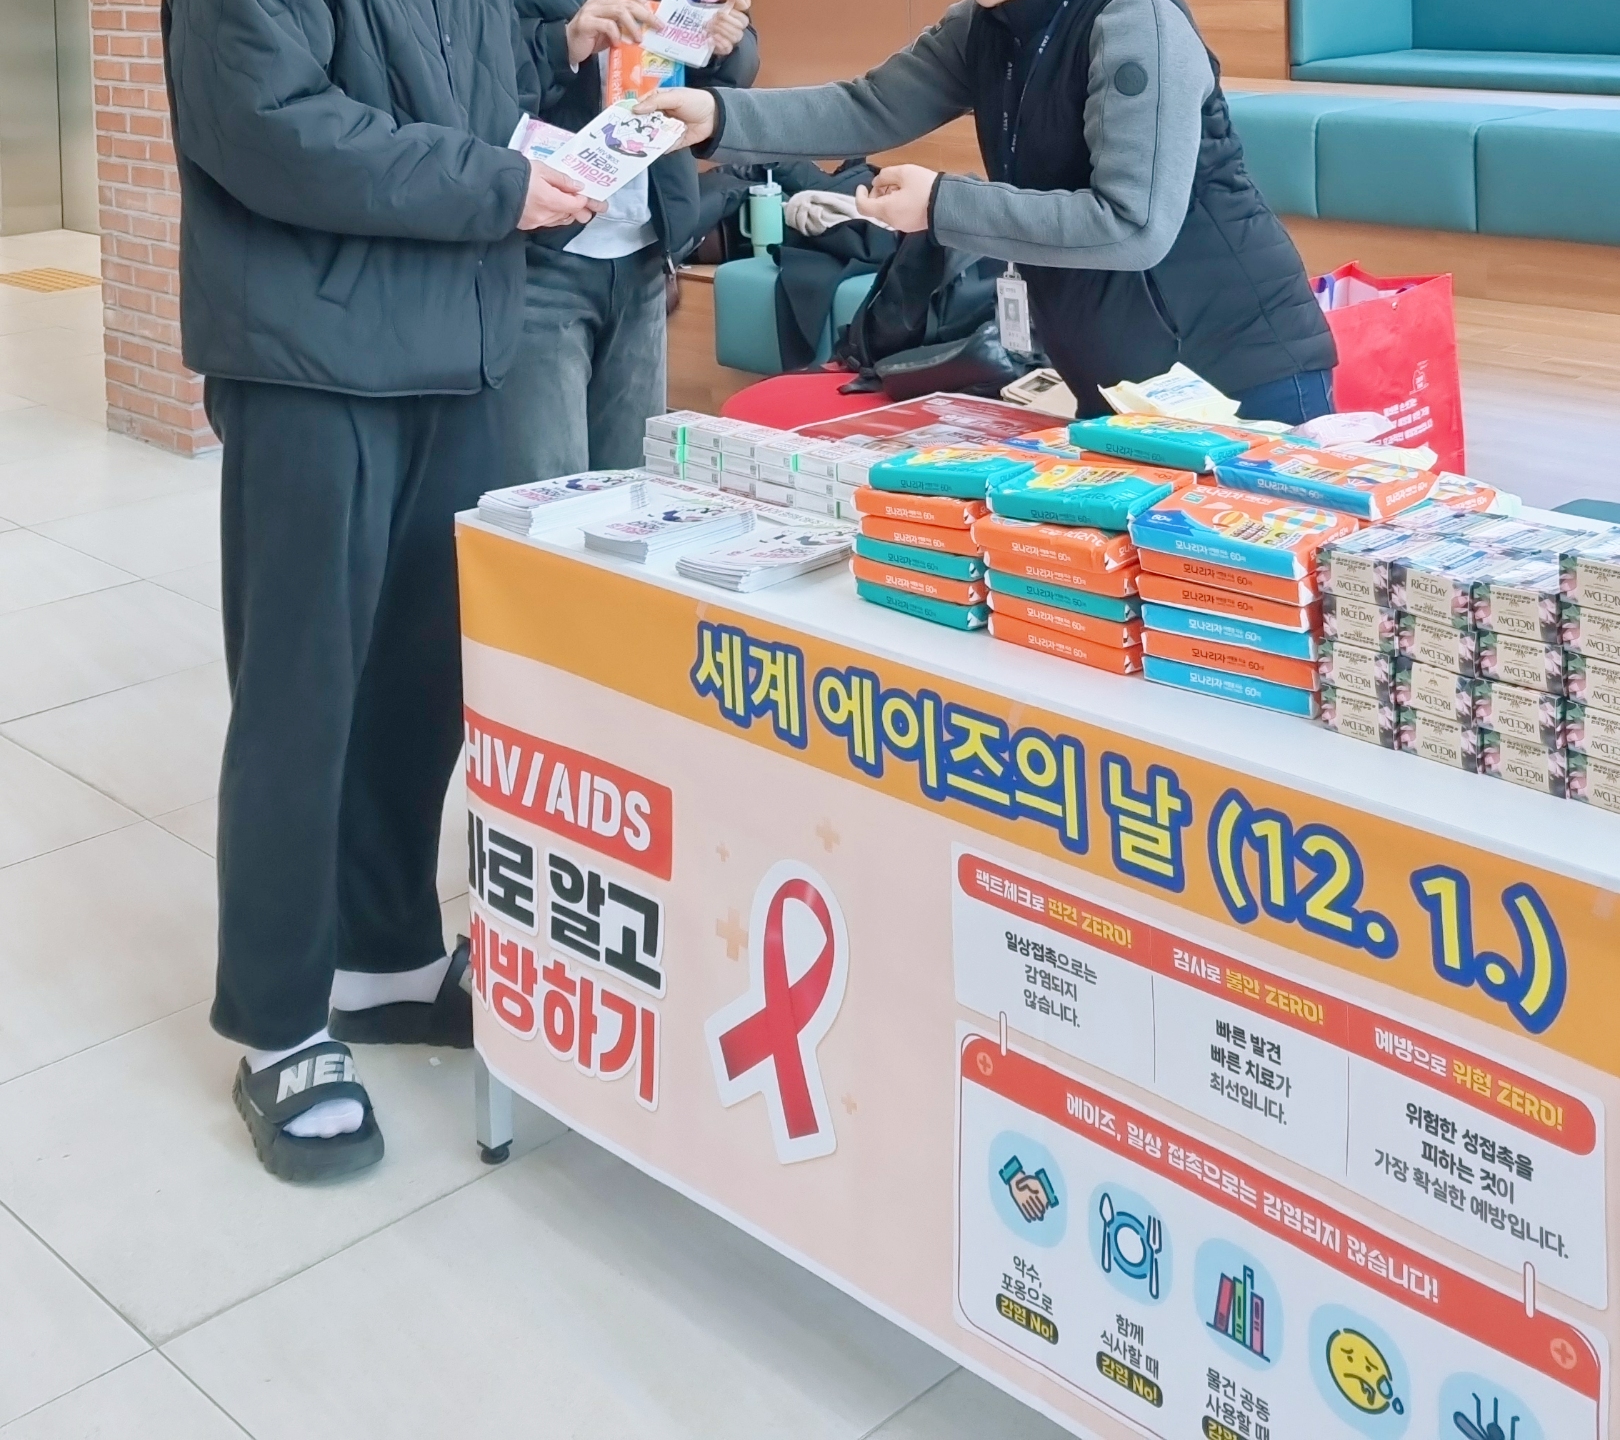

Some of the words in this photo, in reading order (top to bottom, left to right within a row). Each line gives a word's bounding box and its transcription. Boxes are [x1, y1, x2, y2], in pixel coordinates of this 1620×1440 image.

[1336, 580, 1351, 589] DAY
[1352, 582, 1370, 595] RICE
[1411, 578, 1429, 592] RICE
[1430, 583, 1447, 597] DAY
[1583, 589, 1601, 601] DAY
[1340, 607, 1357, 620] RICE
[1358, 611, 1375, 623] DAY
[1497, 615, 1514, 627] DAY
[1515, 619, 1535, 631] RICE
[1420, 646, 1435, 658] DAY
[1586, 639, 1604, 652] DAY
[1436, 651, 1454, 665] RICE
[1338, 671, 1353, 683] DAY
[1503, 665, 1520, 677] DAY
[1521, 669, 1541, 682] RICE
[1354, 675, 1371, 689] RICE
[1416, 692, 1432, 704] DAY
[1433, 696, 1451, 711] RICE
[1592, 690, 1610, 703] DAY
[1341, 719, 1356, 731] DAY
[1357, 721, 1375, 736] RICE
[1498, 715, 1514, 728] DAY
[1515, 719, 1535, 734] RICE
[1421, 740, 1437, 754] DAY
[1438, 746, 1456, 760] RICE
[1591, 741, 1609, 753] DAY
[1506, 763, 1523, 776] DAY
[1524, 768, 1544, 783] RICE
[465, 720, 651, 852] HIV/AIDS
[1593, 789, 1611, 802] DAY
[694, 625, 803, 743] 세계
[816, 671, 1084, 847] 에이즈의
[1105, 756, 1186, 885] 날
[1212, 794, 1391, 951] (12.
[1417, 870, 1559, 1025] 1.)
[975, 868, 1045, 912] 팩트체크로
[1048, 898, 1078, 926] 편견
[1081, 912, 1132, 949] ZERO!
[548, 853, 661, 991] 알고
[1005, 931, 1097, 985] 일상접촉으로는
[1024, 964, 1078, 1002] 감염되지
[1173, 948, 1221, 984] 검사로
[1226, 968, 1260, 999] 불안
[1264, 984, 1324, 1025] ZERO!
[1023, 989, 1081, 1028] 않습니다.
[1215, 1019, 1246, 1049] 빠른
[1250, 1033, 1282, 1066] 발견
[1210, 1043, 1241, 1075] 빠른
[1245, 1060, 1292, 1098] 치료가
[1374, 1027, 1446, 1077] 예방으로
[1453, 1059, 1492, 1098] 위험
[1496, 1079, 1564, 1131] ZERO!
[1209, 1072, 1287, 1125] 최선입니다.
[1406, 1102, 1457, 1145] 위험한
[1462, 1129, 1534, 1182] 성접촉을
[1421, 1140, 1474, 1184] 피하는
[1480, 1167, 1515, 1204] 것이
[1066, 1092, 1122, 1142] 에이즈,
[1126, 1121, 1162, 1159] 일상
[1167, 1142, 1257, 1210] 접촉으로는
[1263, 1191, 1341, 1252] 감염되지
[1346, 1234, 1440, 1304] 않습니다!
[1374, 1148, 1409, 1183] 가장
[1412, 1167, 1466, 1212] 확실한
[1470, 1195, 1569, 1259] 예방입니다.
[1013, 1255, 1042, 1288] 악수,
[1000, 1272, 1053, 1316] 포옹으로
[1001, 1296, 1027, 1326] 감염
[1030, 1314, 1053, 1341] No!
[1115, 1313, 1144, 1347] 함께
[1100, 1329, 1141, 1369] 식사할
[1145, 1354, 1159, 1380] 때
[1102, 1355, 1128, 1388] 감염
[1133, 1374, 1157, 1404] No!
[1206, 1367, 1236, 1402] 물건
[1240, 1387, 1270, 1423] 공동
[1205, 1393, 1252, 1437] 사용할
